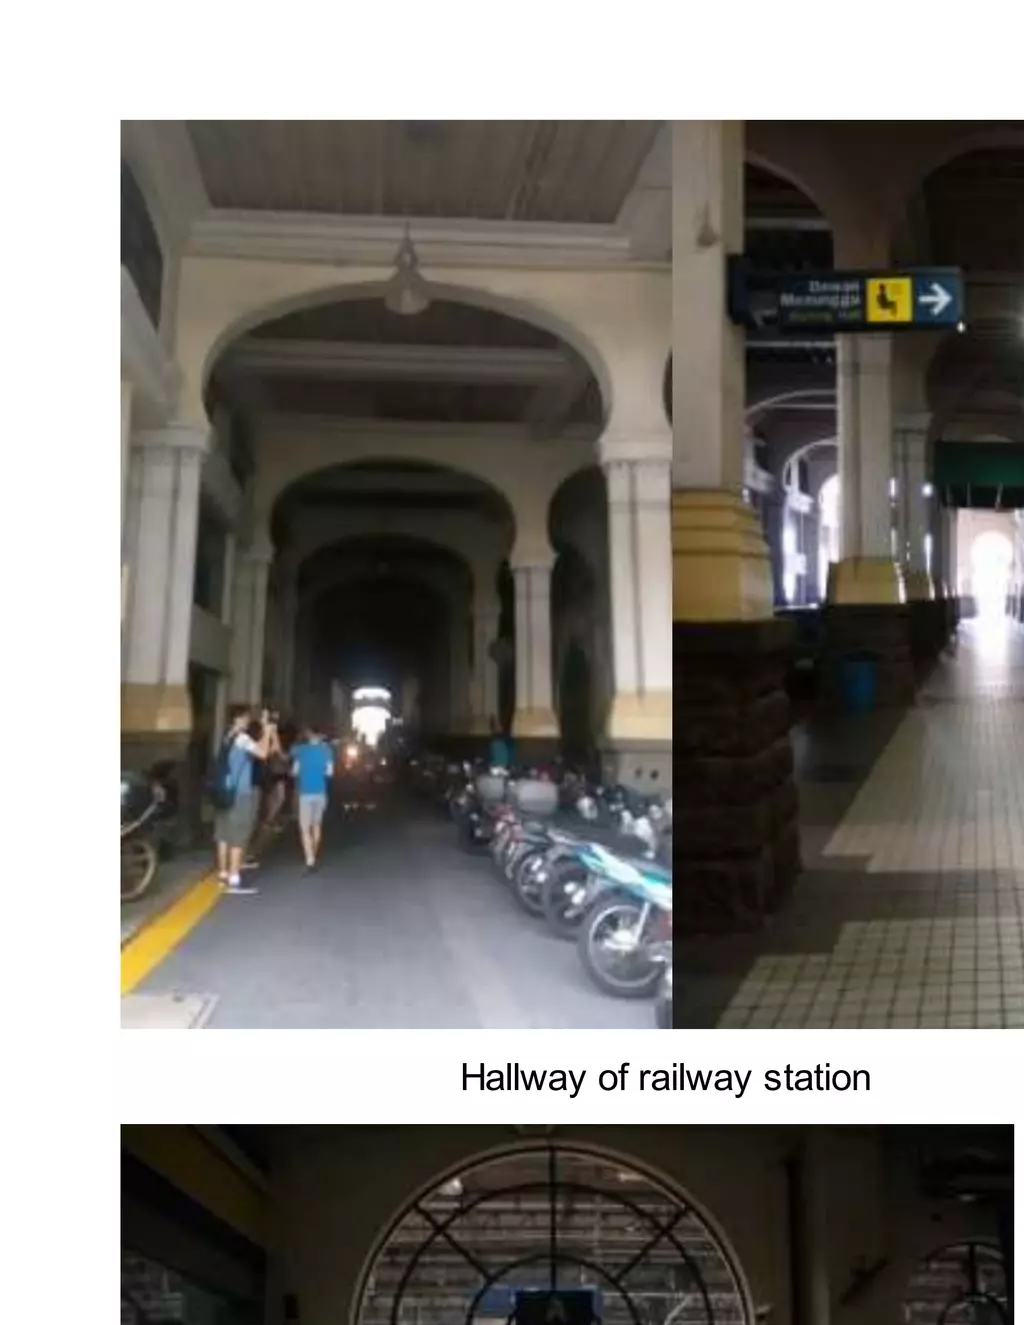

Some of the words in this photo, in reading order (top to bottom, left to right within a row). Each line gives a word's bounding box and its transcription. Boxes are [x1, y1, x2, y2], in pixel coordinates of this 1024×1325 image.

[462, 1062, 587, 1099] Hallway
[598, 1061, 631, 1092] of
[639, 1062, 753, 1099] railway
[764, 1062, 871, 1092] station
